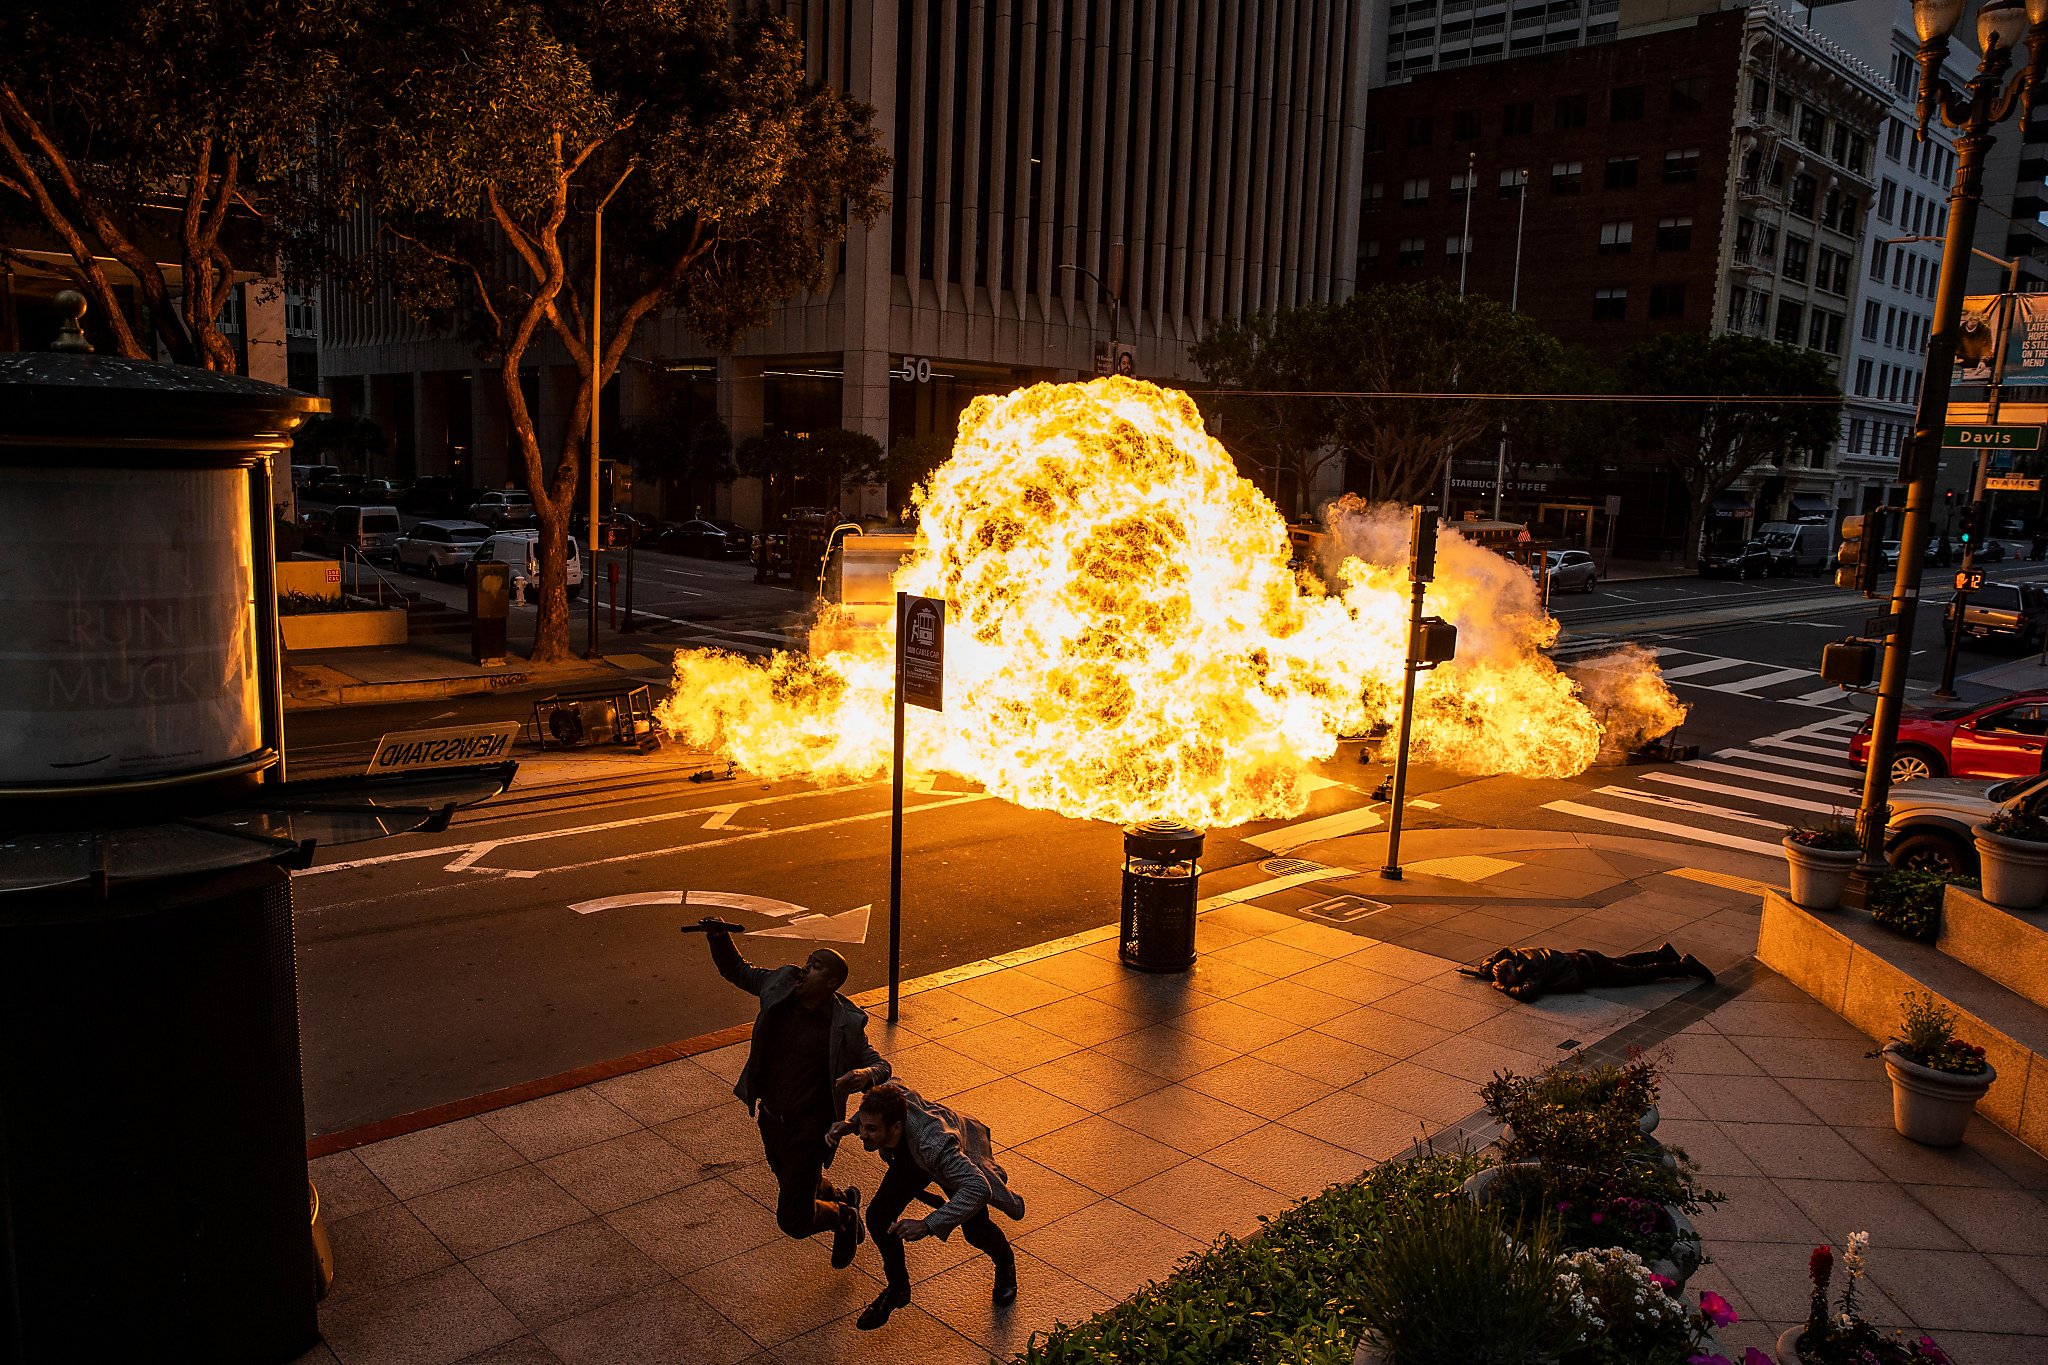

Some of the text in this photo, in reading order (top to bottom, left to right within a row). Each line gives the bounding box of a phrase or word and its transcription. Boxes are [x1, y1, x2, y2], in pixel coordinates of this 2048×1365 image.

[2022, 341, 2030, 350] IS
[2022, 350, 2048, 359] ON THE
[902, 356, 931, 383] 50
[2023, 359, 2045, 368] MENU
[1960, 431, 2012, 443] Davis
[1990, 480, 2035, 489] DAVIS
[1970, 574, 1981, 589] 12
[67, 604, 175, 647] RUN
[915, 647, 930, 657] CABLE
[929, 650, 940, 660] CAR
[47, 660, 197, 706] MUCK
